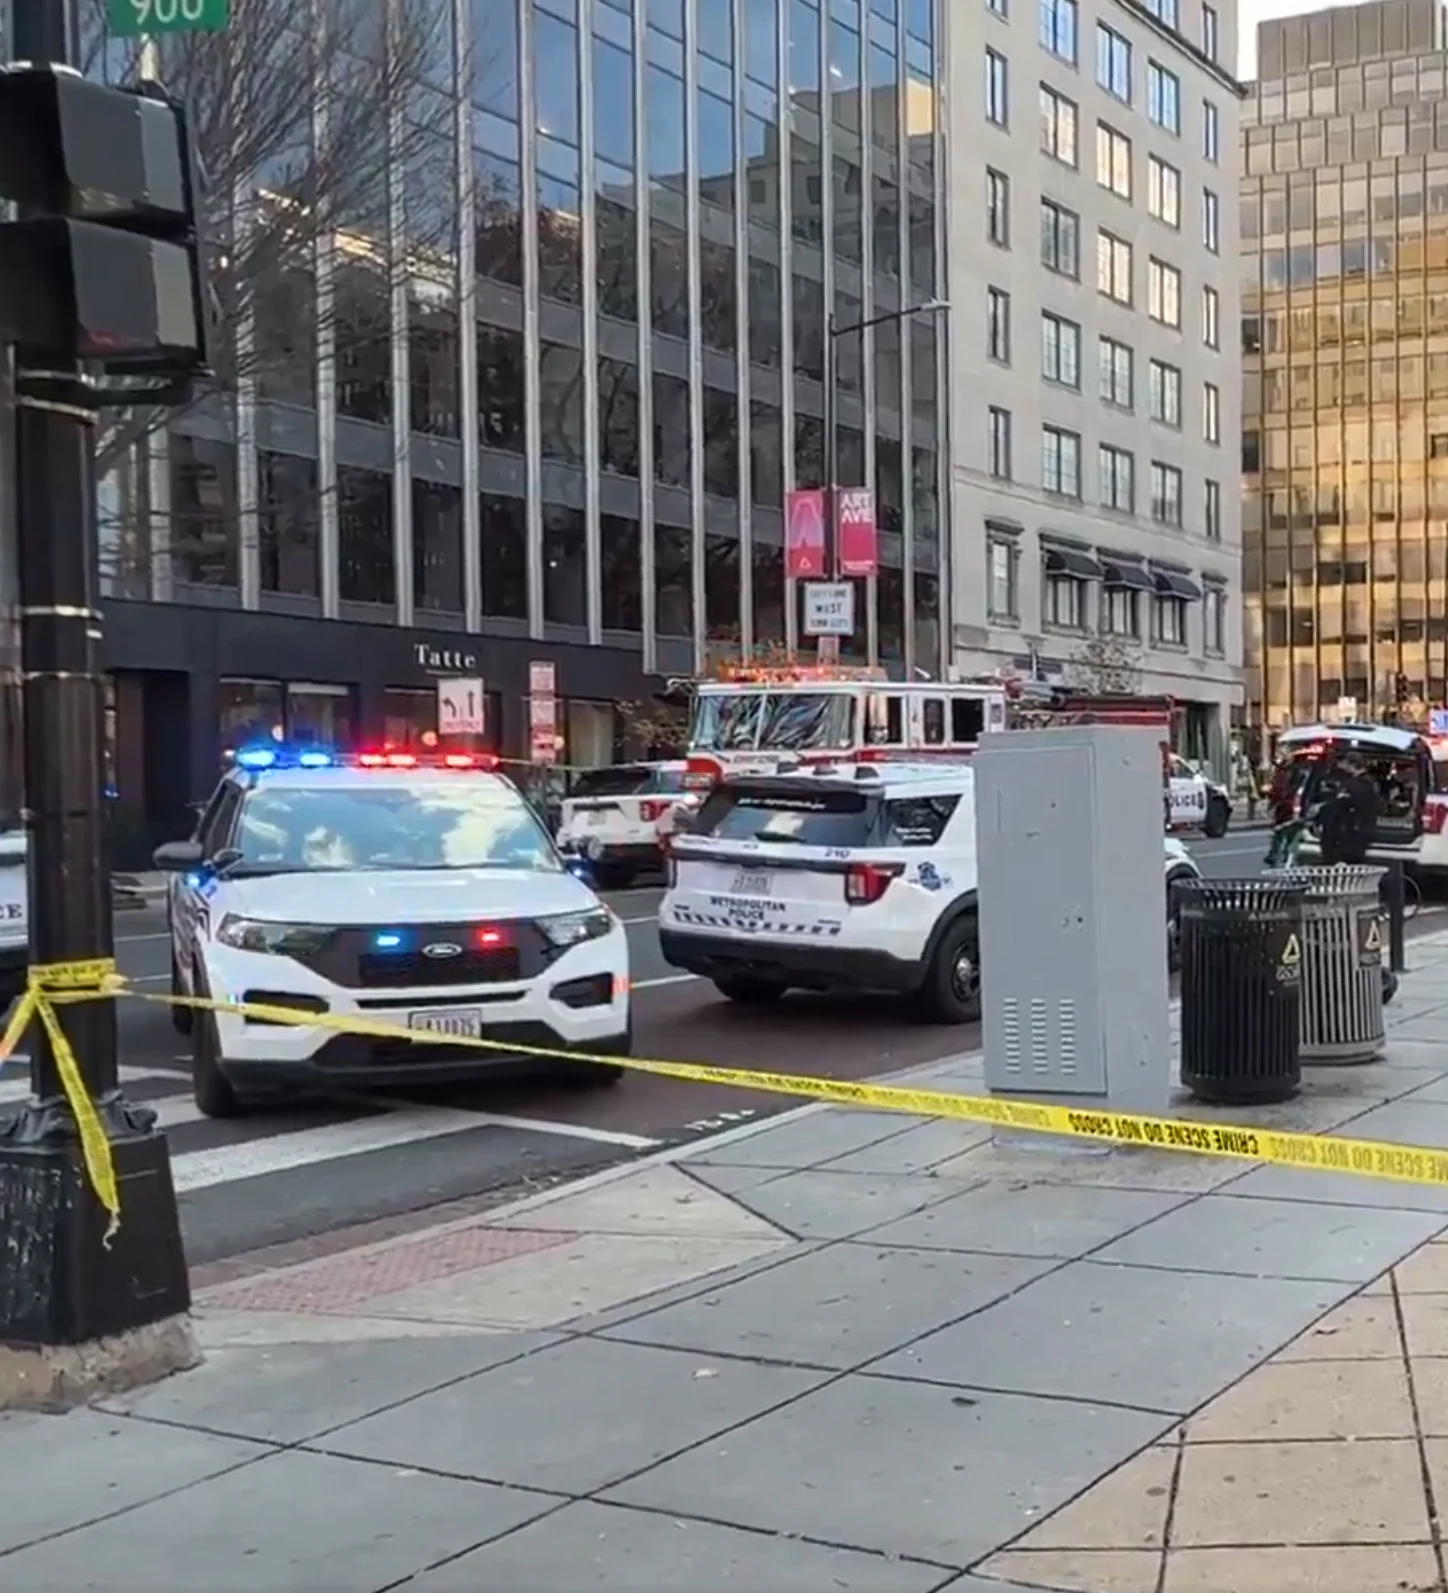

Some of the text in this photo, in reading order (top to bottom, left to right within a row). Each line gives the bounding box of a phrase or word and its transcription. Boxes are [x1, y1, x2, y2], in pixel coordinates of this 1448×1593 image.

[414, 644, 476, 668] Tatte
[728, 908, 765, 921] POLICE
[1113, 1118, 1144, 1139] NOT
[1142, 1121, 1163, 1142] DO
[1163, 1124, 1212, 1149] SCENE
[1211, 1129, 1260, 1154] CRIME
